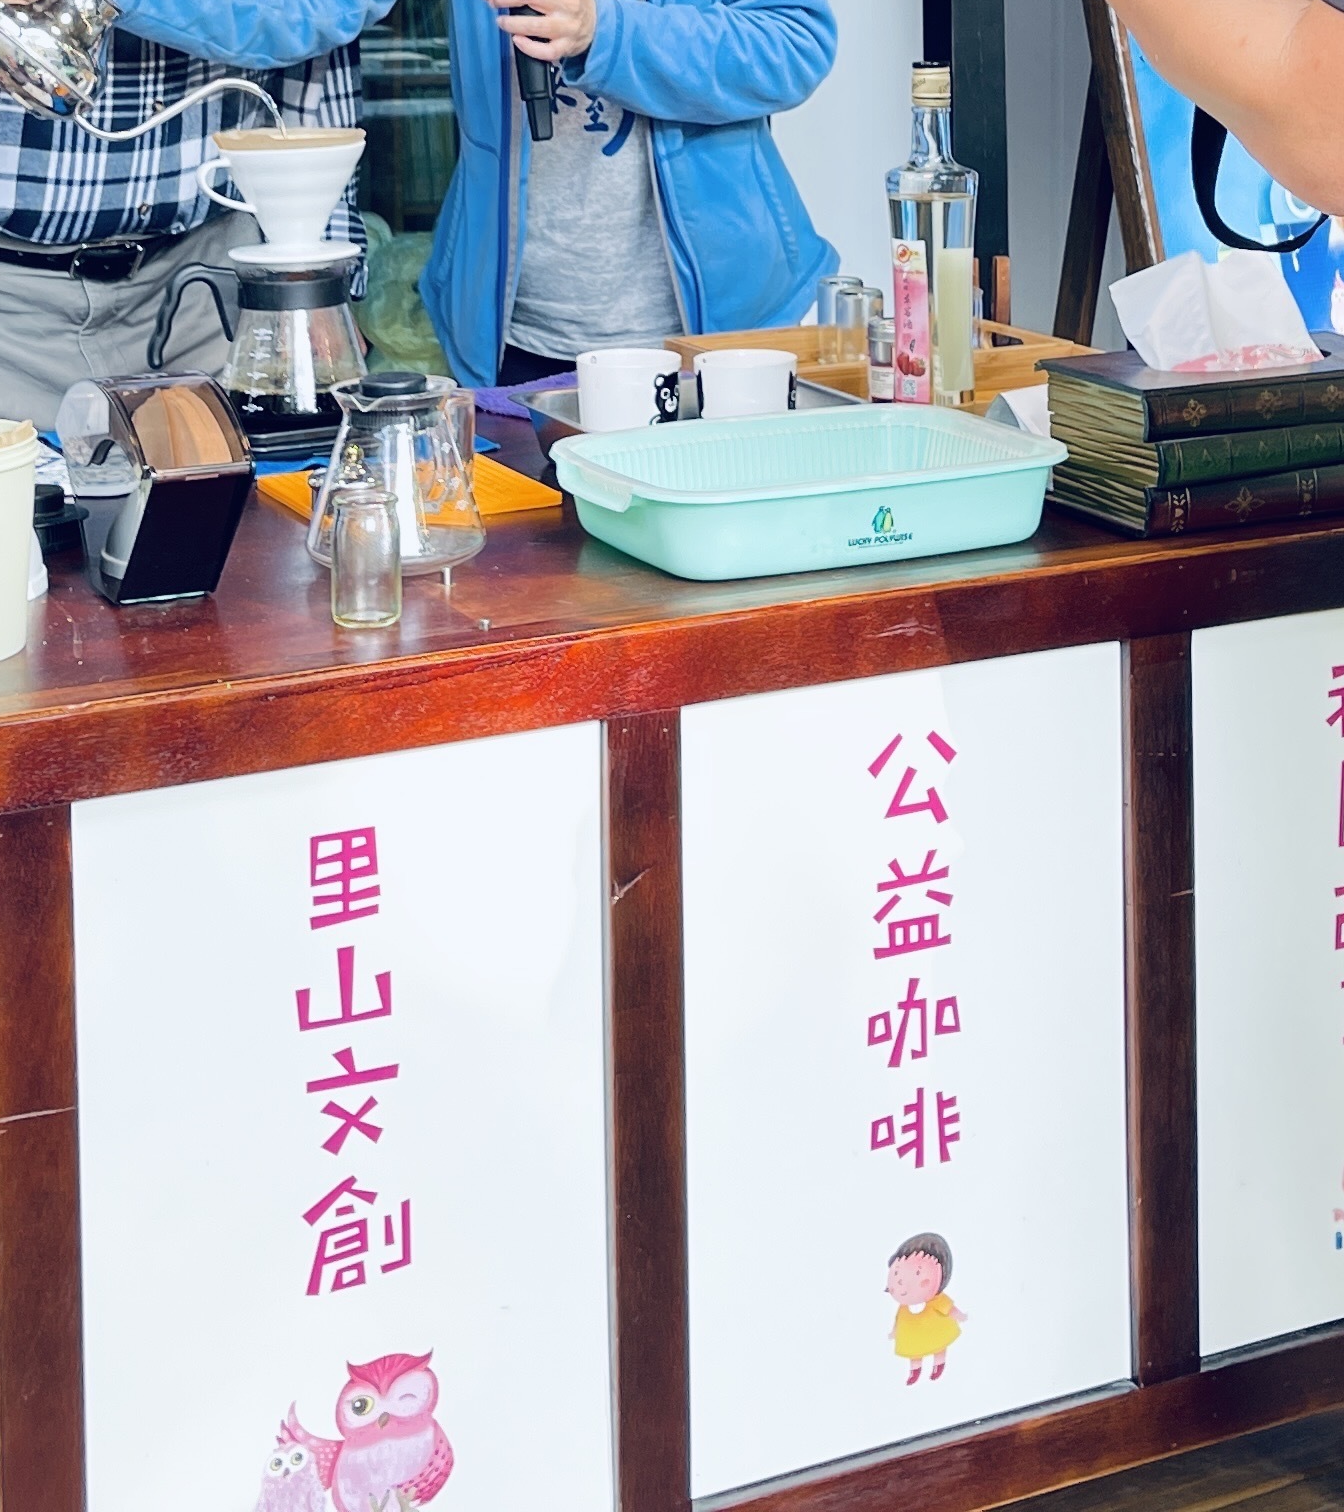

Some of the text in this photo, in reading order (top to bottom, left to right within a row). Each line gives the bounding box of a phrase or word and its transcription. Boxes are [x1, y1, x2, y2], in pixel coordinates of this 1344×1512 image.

[295, 826, 412, 1296] 里山文創
[866, 730, 961, 1168] 公益咖啡
